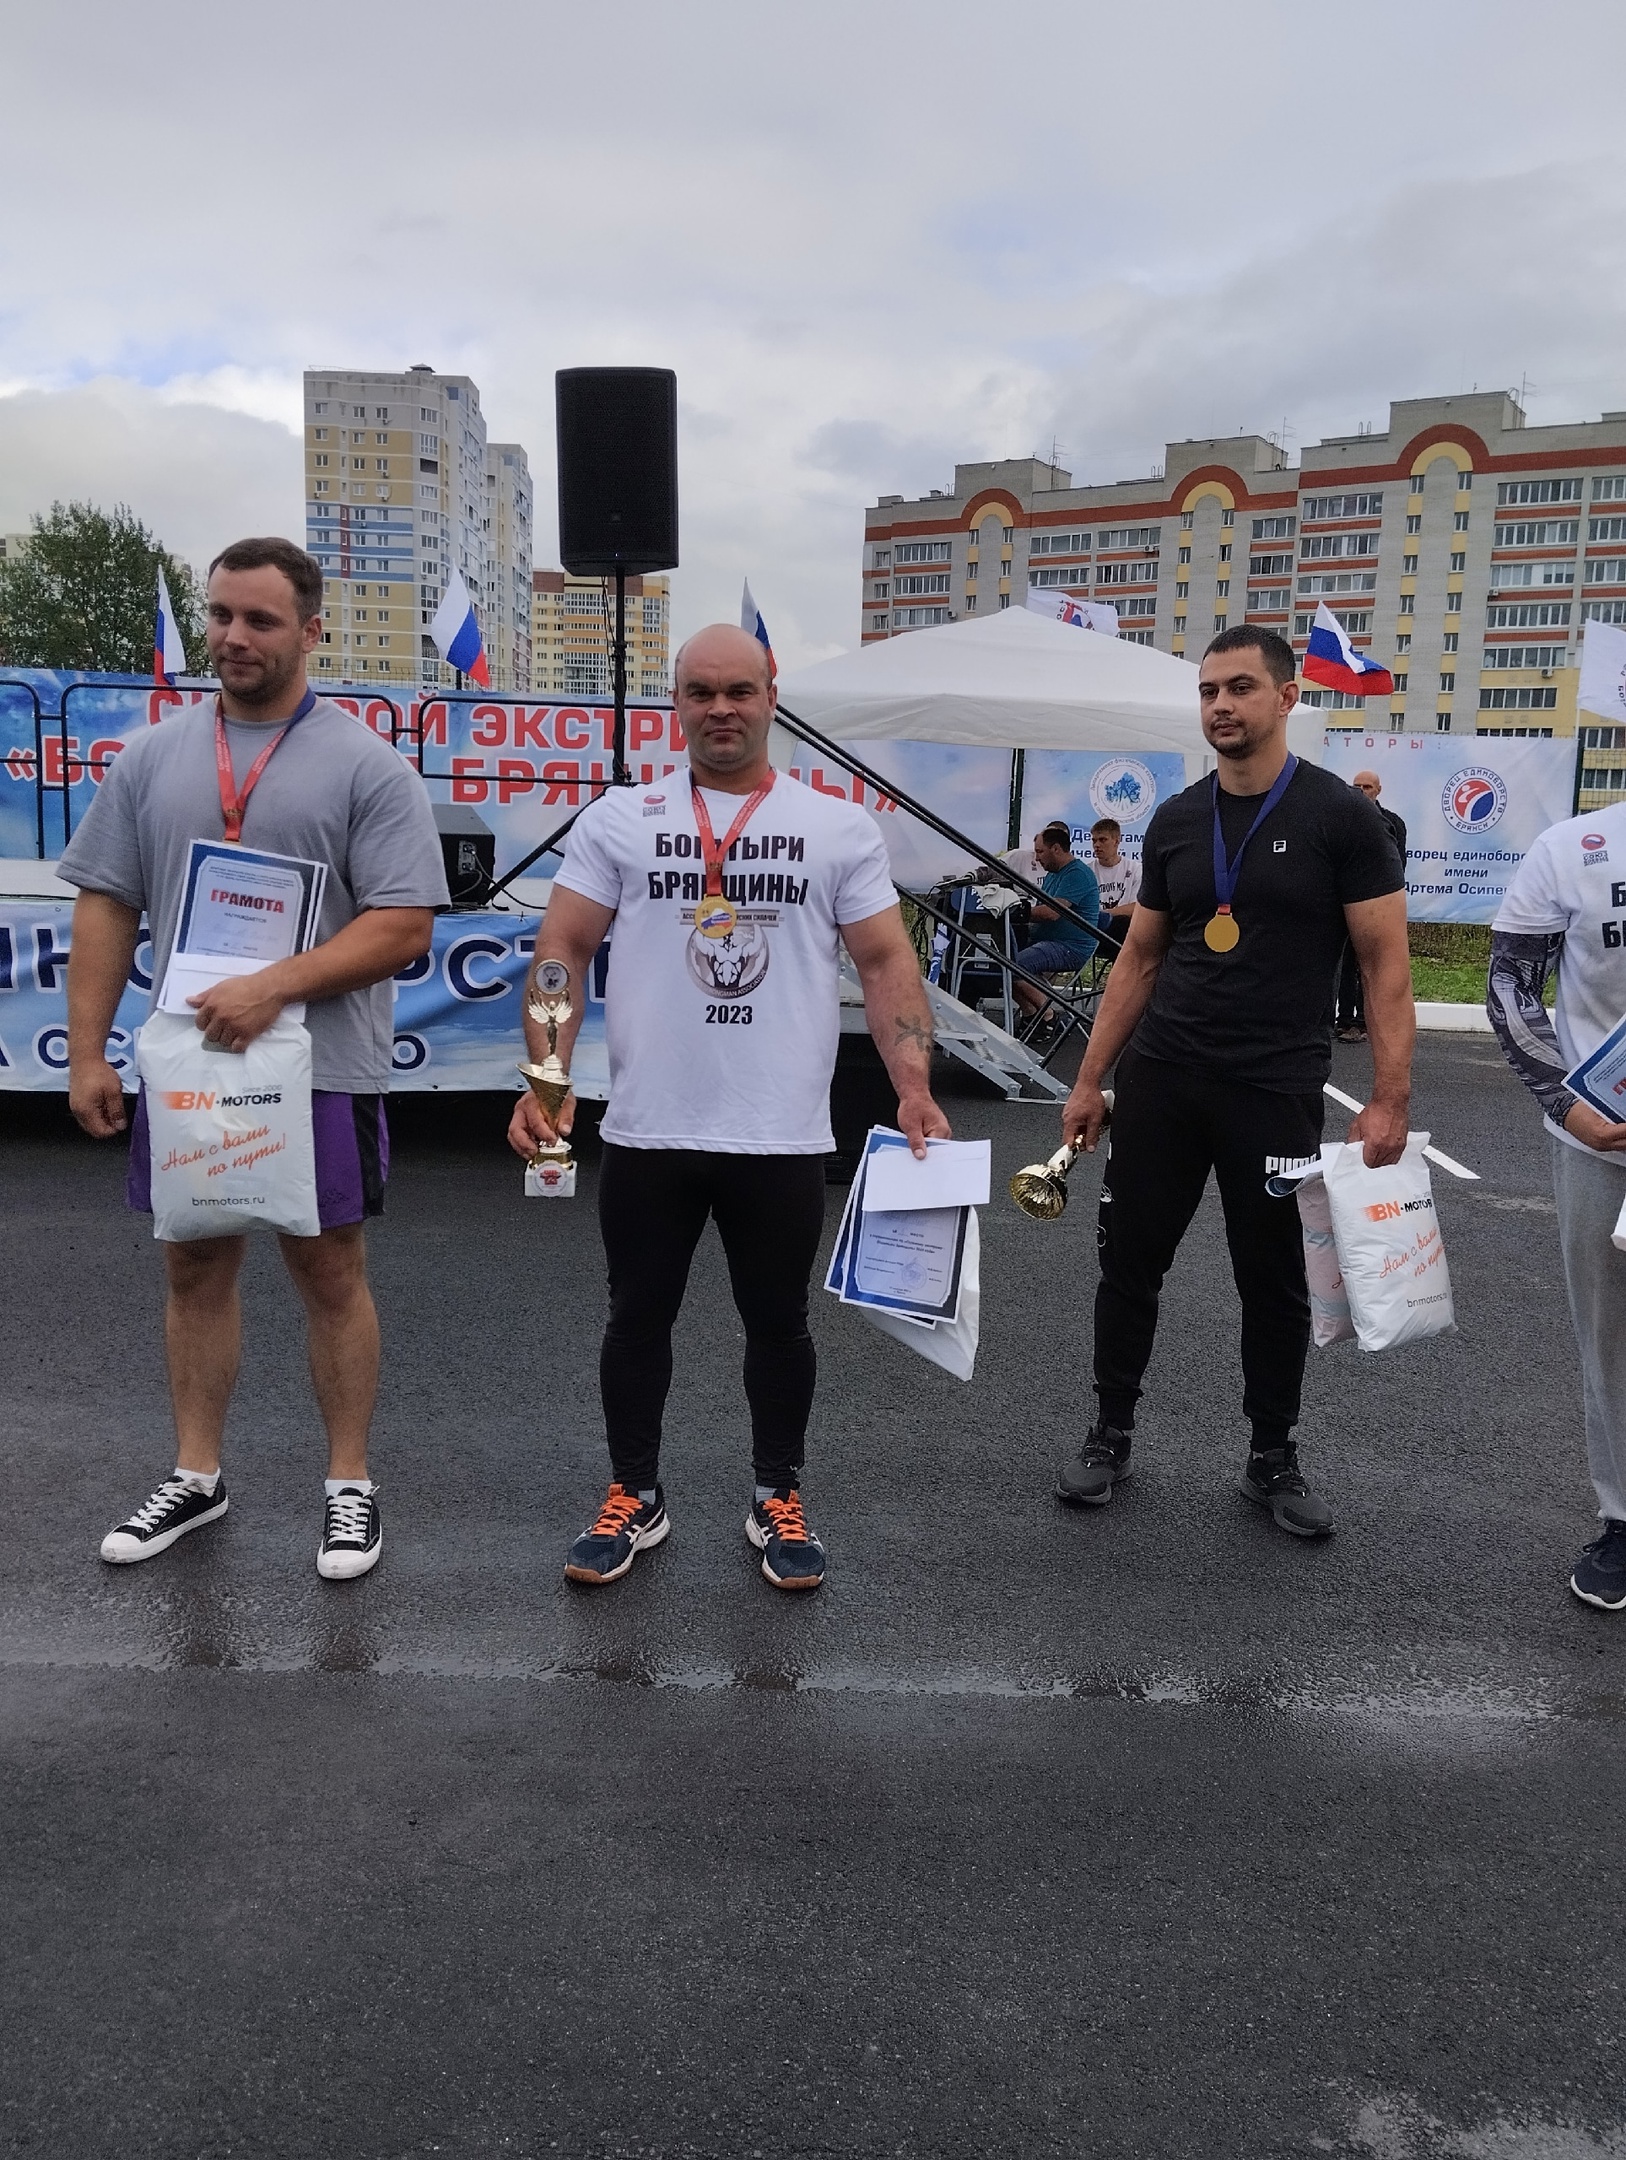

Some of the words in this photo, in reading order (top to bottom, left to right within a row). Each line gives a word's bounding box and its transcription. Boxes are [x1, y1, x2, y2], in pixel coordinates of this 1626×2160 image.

[472, 706, 689, 752] ЭКСТРИ
[1443, 775, 1461, 811] ДВОРЕЦ
[1455, 821, 1489, 832] БРЯНСК
[655, 833, 804, 862] БОТЫРИ
[1405, 850, 1448, 862] ворец
[1453, 850, 1526, 864] единобор
[1444, 868, 1488, 878] имени
[647, 871, 809, 906] БРЯЩИНЫ
[1458, 883, 1507, 895] Осипе
[210, 888, 285, 914] ГРАМОТА
[705, 1004, 753, 1025] 2023
[161, 1147, 206, 1171] Нам
[207, 1162, 228, 1177] по
[232, 1132, 286, 1170] пути!
[191, 1196, 266, 1207] bnmotors.ru
